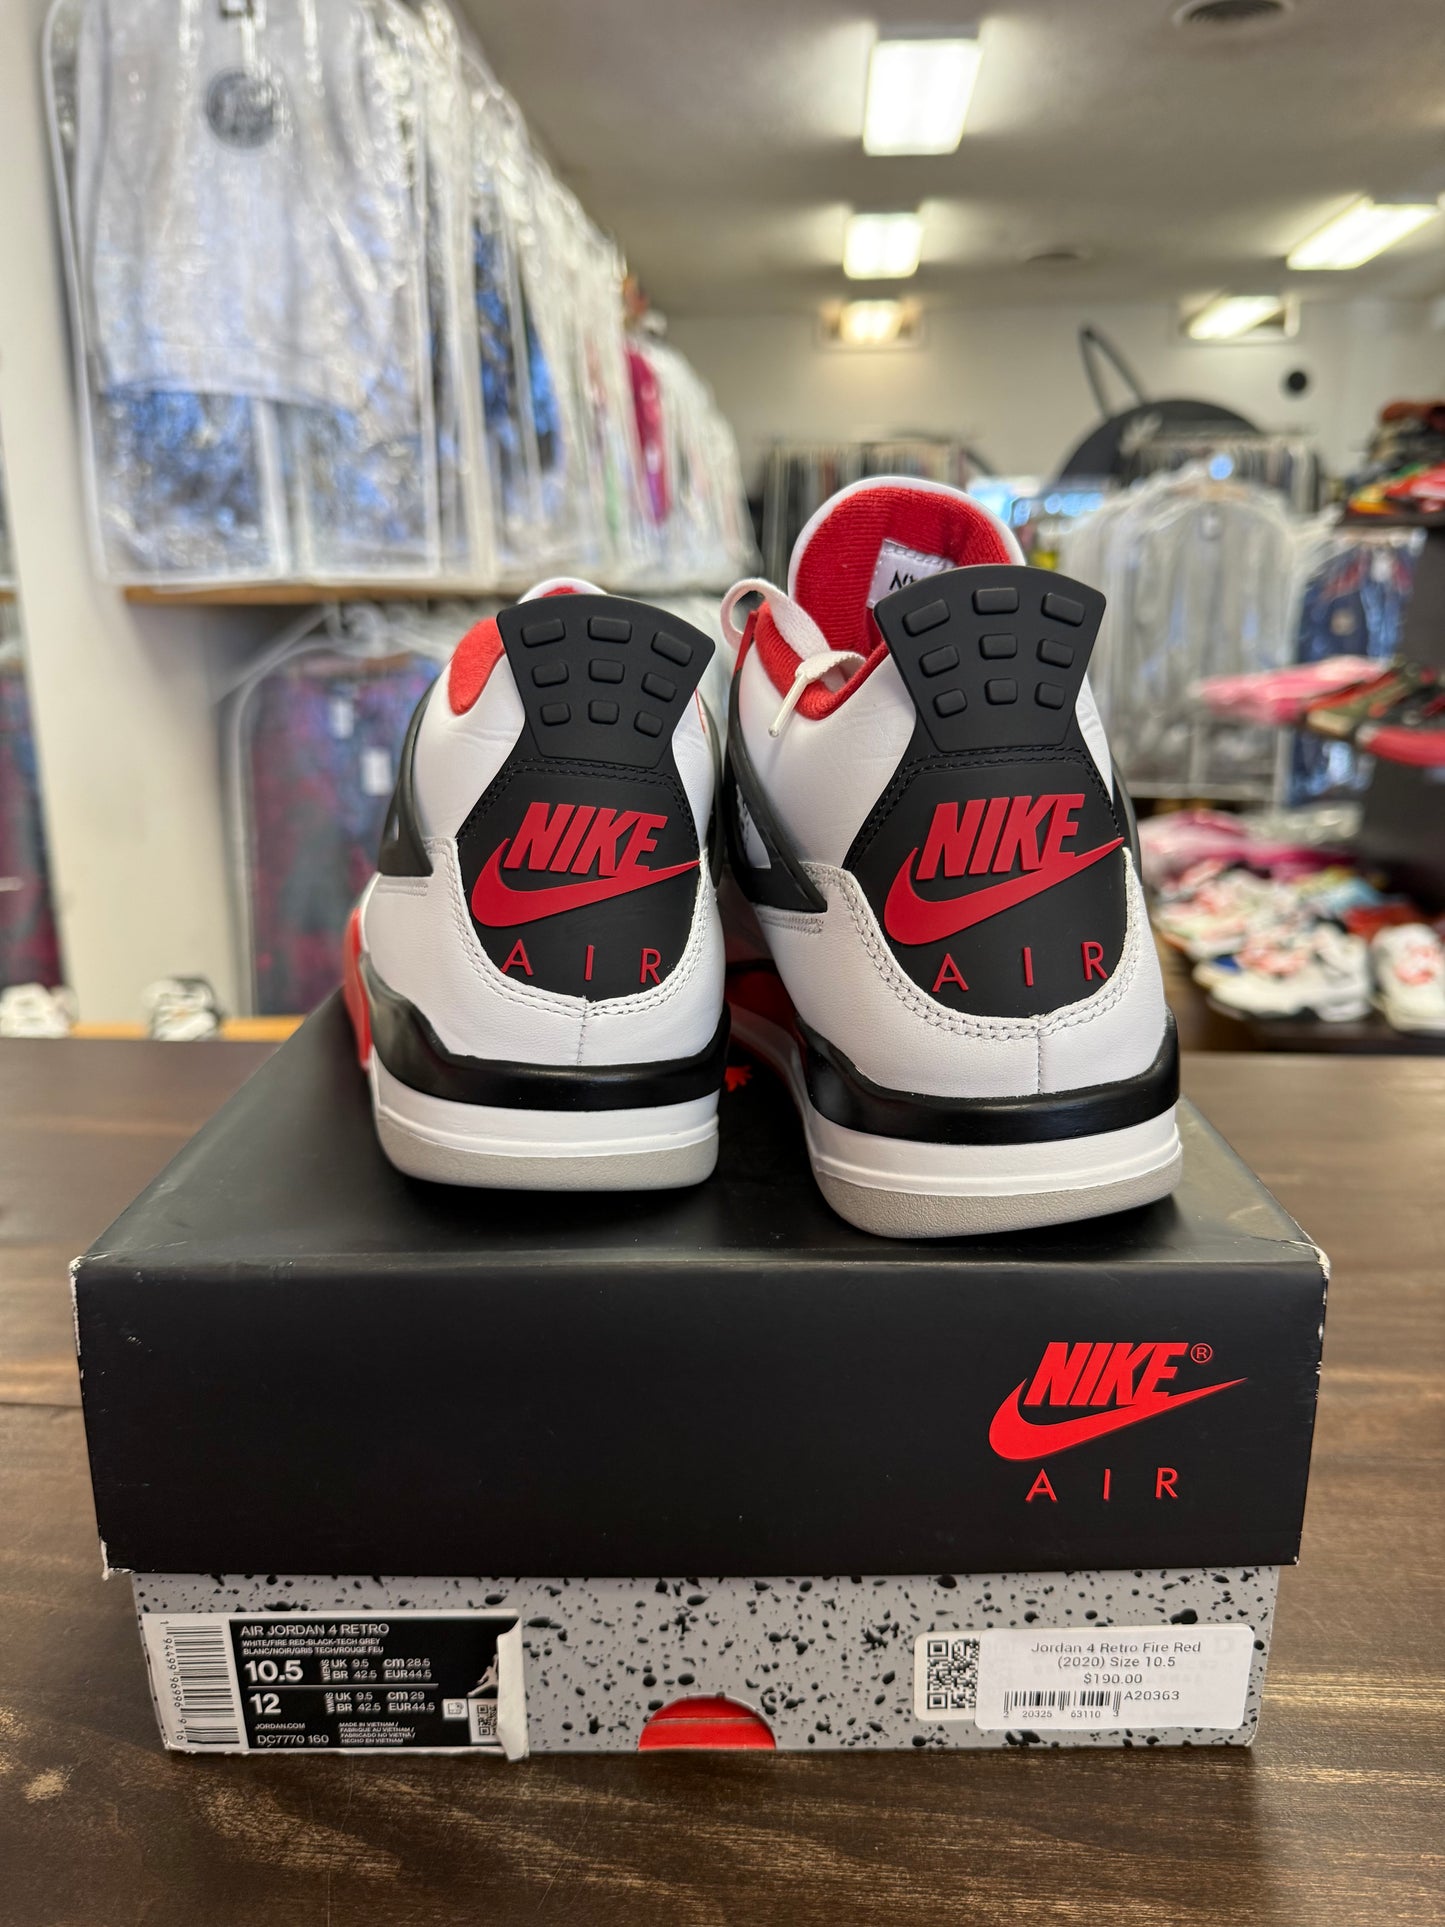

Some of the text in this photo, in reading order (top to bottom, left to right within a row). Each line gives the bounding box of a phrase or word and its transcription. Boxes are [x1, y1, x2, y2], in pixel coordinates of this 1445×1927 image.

[503, 802, 668, 878] NIKE
[916, 794, 1085, 880] NIKE
[501, 938, 661, 984] AIR
[932, 942, 1108, 992] AIR
[1025, 1467, 1178, 1502] AIR
[241, 1623, 390, 1636] AIR JORDAN 4 RETRO
[241, 1638, 381, 1647] WHITE/FIRE RED-BLACK-TECH GREY
[1031, 1642, 1082, 1654] Jordan
[1086, 1642, 1095, 1653] 4
[1099, 1642, 1138, 1653] Retro
[1142, 1641, 1169, 1653] Fire
[1173, 1641, 1202, 1653] Red
[243, 1646, 384, 1655] BLANC/NOIR/GRIS TECH/ROUGE FEU
[331, 1658, 431, 1668] UK 9.5 cm 28.5
[1057, 1656, 1176, 1669] (2020) Size 10.5
[163, 1638, 177, 1671] 94499
[170, 1677, 183, 1708] 96996
[244, 1659, 304, 1681] 10.5
[332, 1670, 349, 1679] BR
[353, 1670, 378, 1679] 42.5
[1083, 1672, 1143, 1685] $190.00
[335, 1691, 425, 1701] UK 9.5 cm 29
[1124, 1690, 1180, 1701] A20363
[249, 1693, 282, 1714] 12
[336, 1703, 353, 1712] BR
[358, 1702, 382, 1712] 42.5
[1003, 1709, 1119, 1718] 2 20325 63110 3
[255, 1722, 306, 1731] JORDAN.COM
[256, 1734, 329, 1744] DC7770 160
